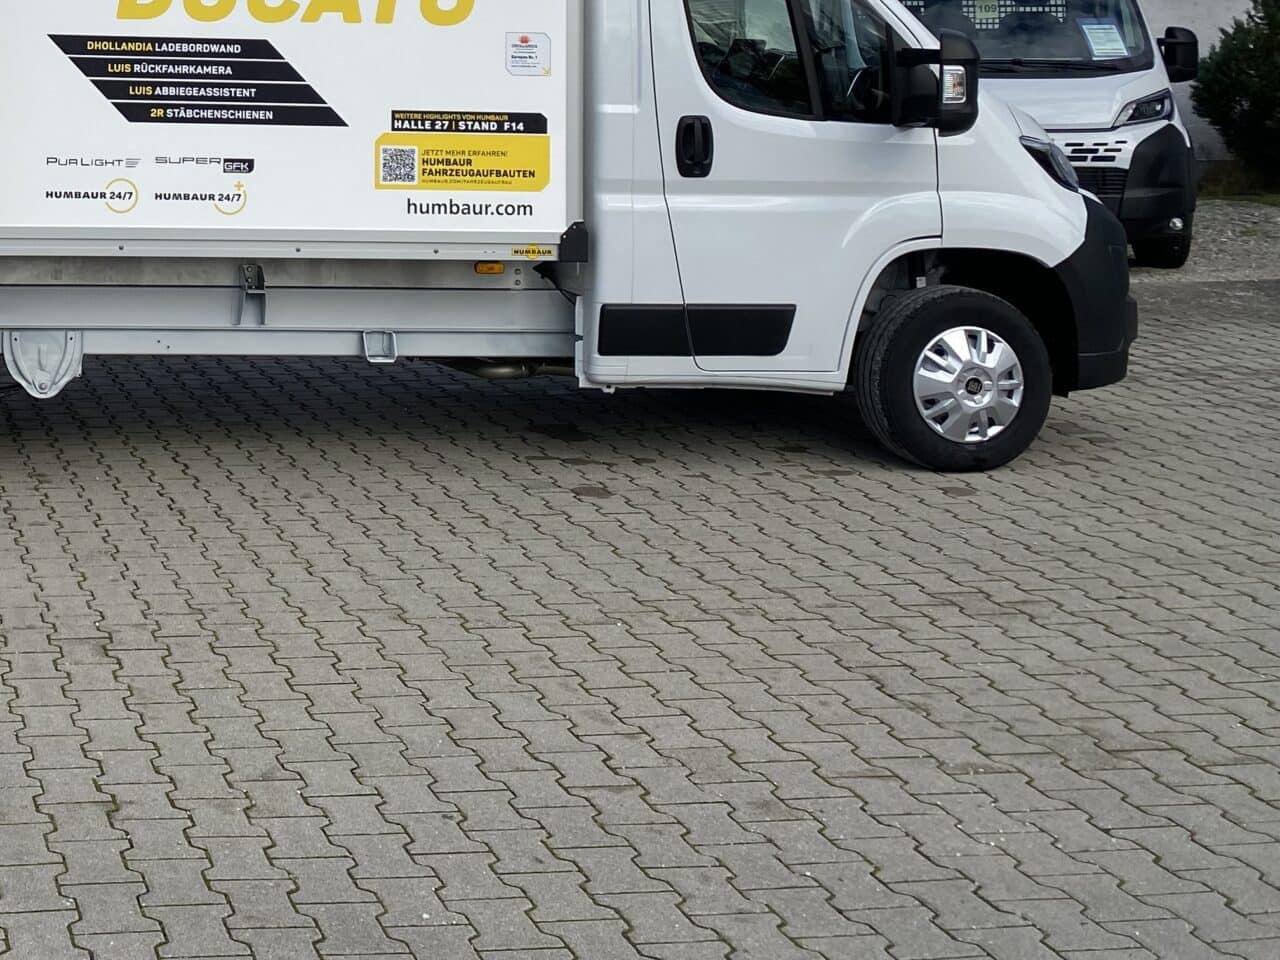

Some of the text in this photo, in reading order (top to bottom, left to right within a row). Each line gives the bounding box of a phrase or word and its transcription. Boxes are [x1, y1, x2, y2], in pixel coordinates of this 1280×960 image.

[87, 41, 241, 54] DHOLLANDIA LADEBORDWAND
[108, 63, 232, 75] LUIS RÜCKFAHRKAMERA
[129, 86, 257, 98] LUIS ABBIEGEASSISTENT
[150, 107, 273, 120] 2R STÄBCHENSCHIENEN
[394, 120, 525, 131] HALLE 27 STAND F14
[468, 150, 508, 158] ERFAHREN!
[154, 156, 222, 165] SUPER
[422, 158, 472, 167] HUMBAUR
[422, 168, 536, 178] FAHRZEUGAUFBAUTEN
[45, 191, 133, 201] HUMBAUR 24/7
[154, 192, 242, 202] HUMBAUR 24/7
[407, 198, 533, 216] humbaur.com
